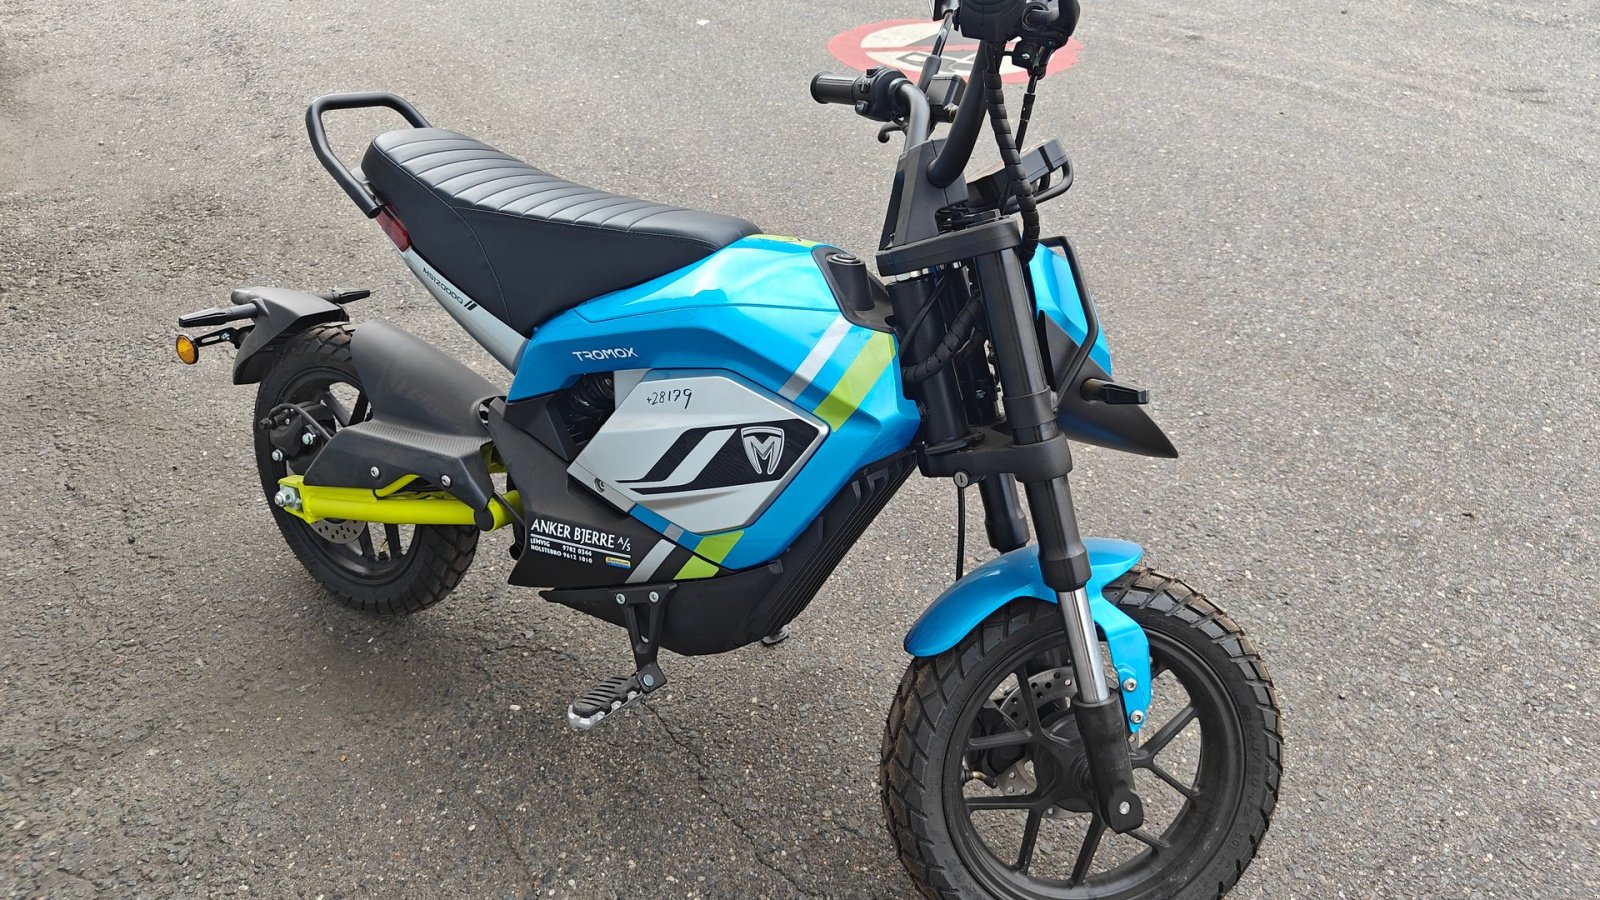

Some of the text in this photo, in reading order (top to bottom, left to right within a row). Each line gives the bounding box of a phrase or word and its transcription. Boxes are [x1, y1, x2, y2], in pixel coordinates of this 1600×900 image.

[572, 347, 638, 361] TROMOX
[531, 519, 631, 552] ANKER BJERRE A/S
[530, 538, 551, 548] LEMVIG
[530, 545, 562, 556] HOLSTEBRO
